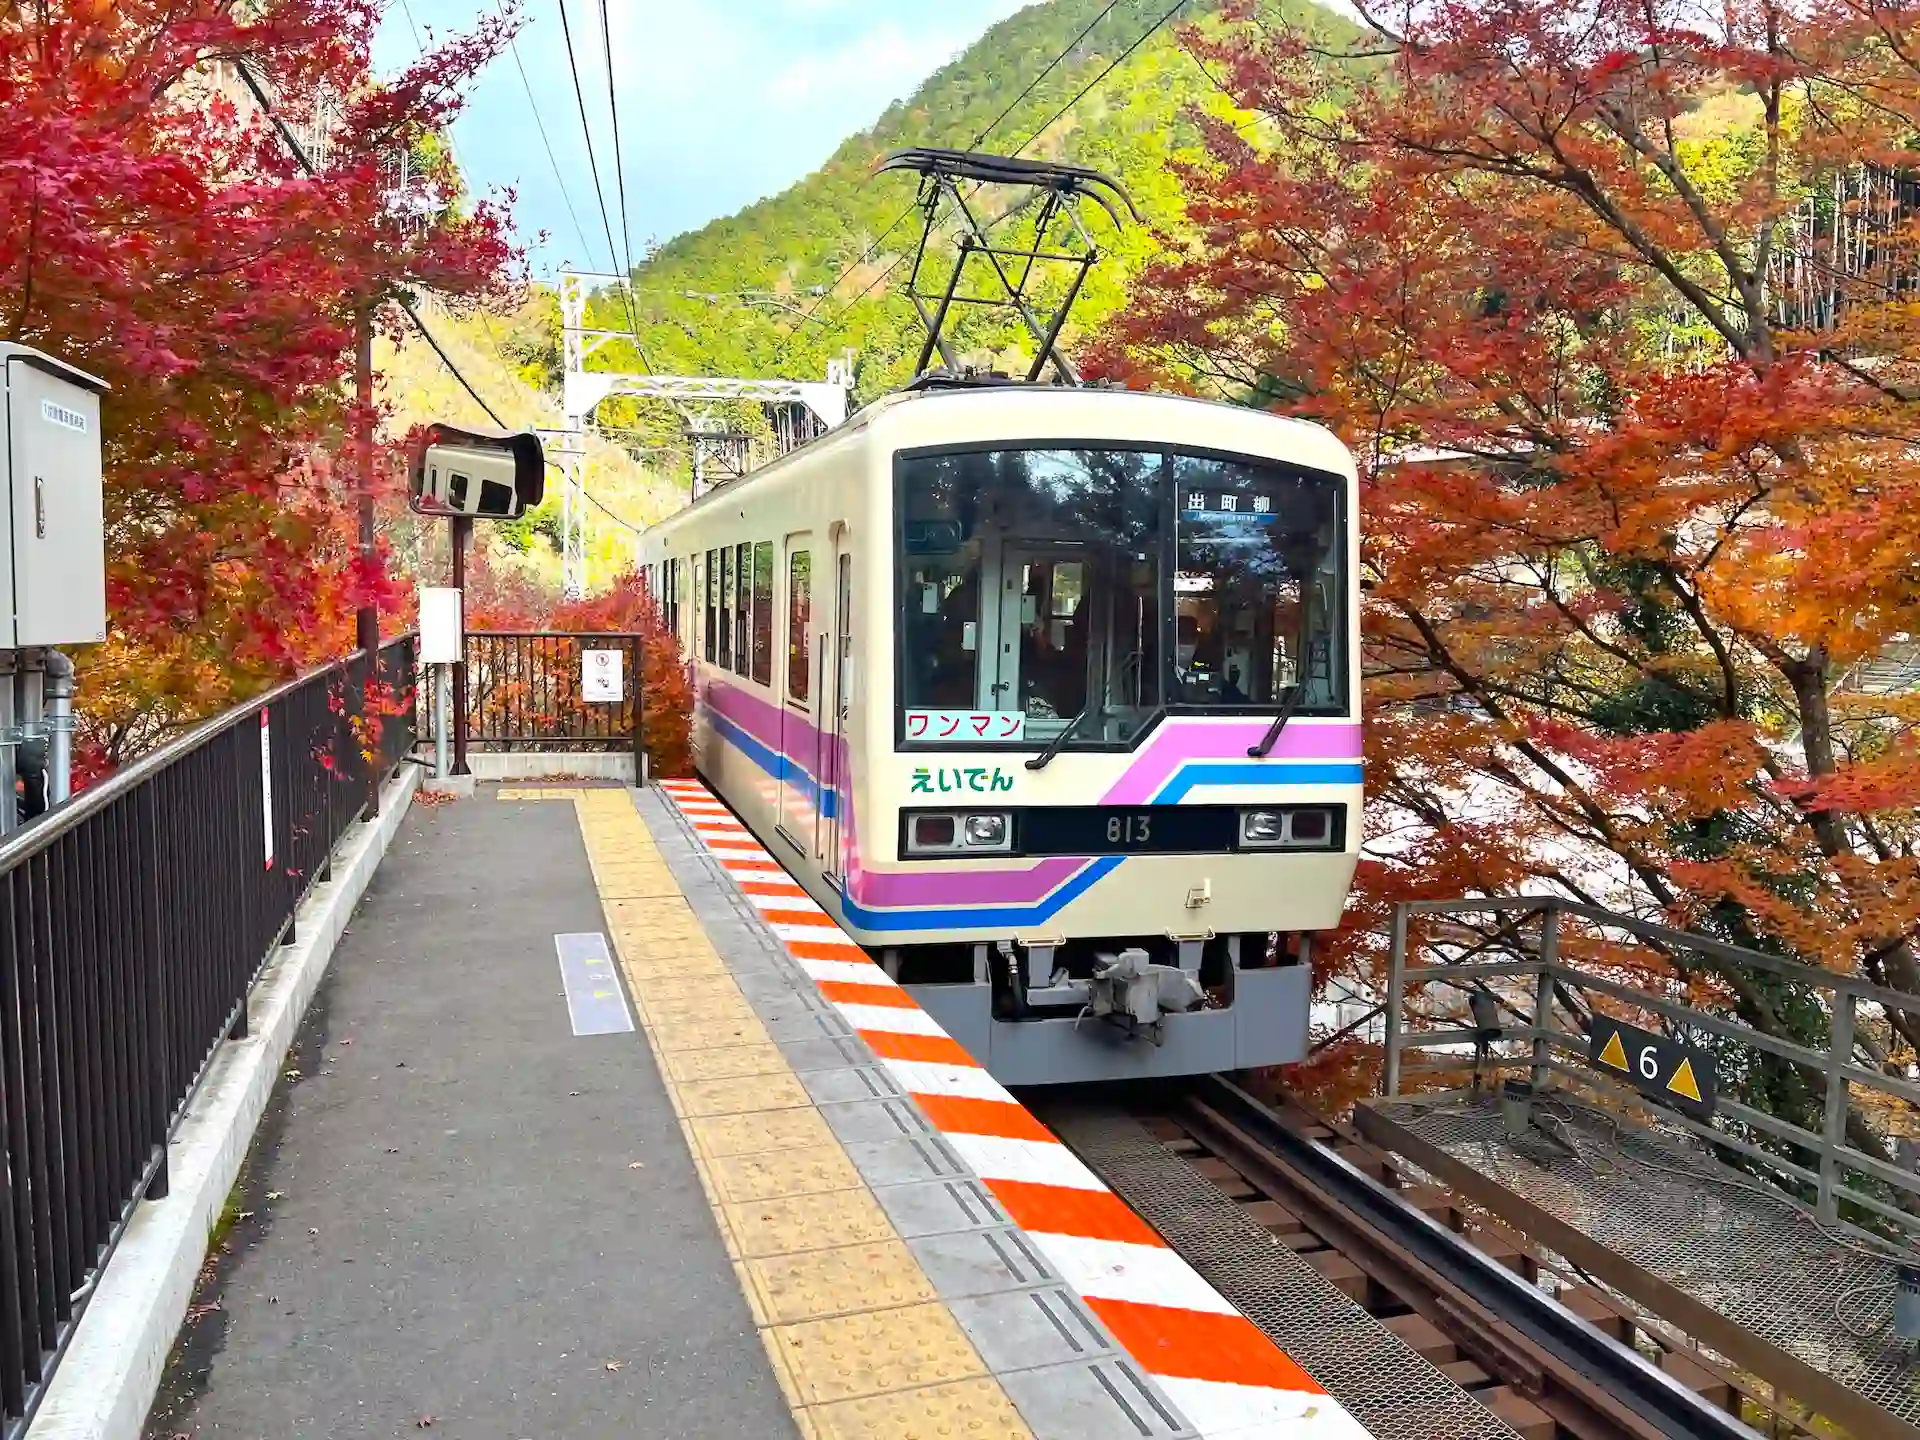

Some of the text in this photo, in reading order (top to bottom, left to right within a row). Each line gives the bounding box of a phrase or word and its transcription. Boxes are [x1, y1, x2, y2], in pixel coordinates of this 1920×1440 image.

[1188, 493, 1270, 513] 出町柳
[908, 715, 1020, 737] ワンマン
[911, 767, 1014, 793] えいでん
[1107, 815, 1150, 842] 813
[1639, 1045, 1659, 1080] 6
